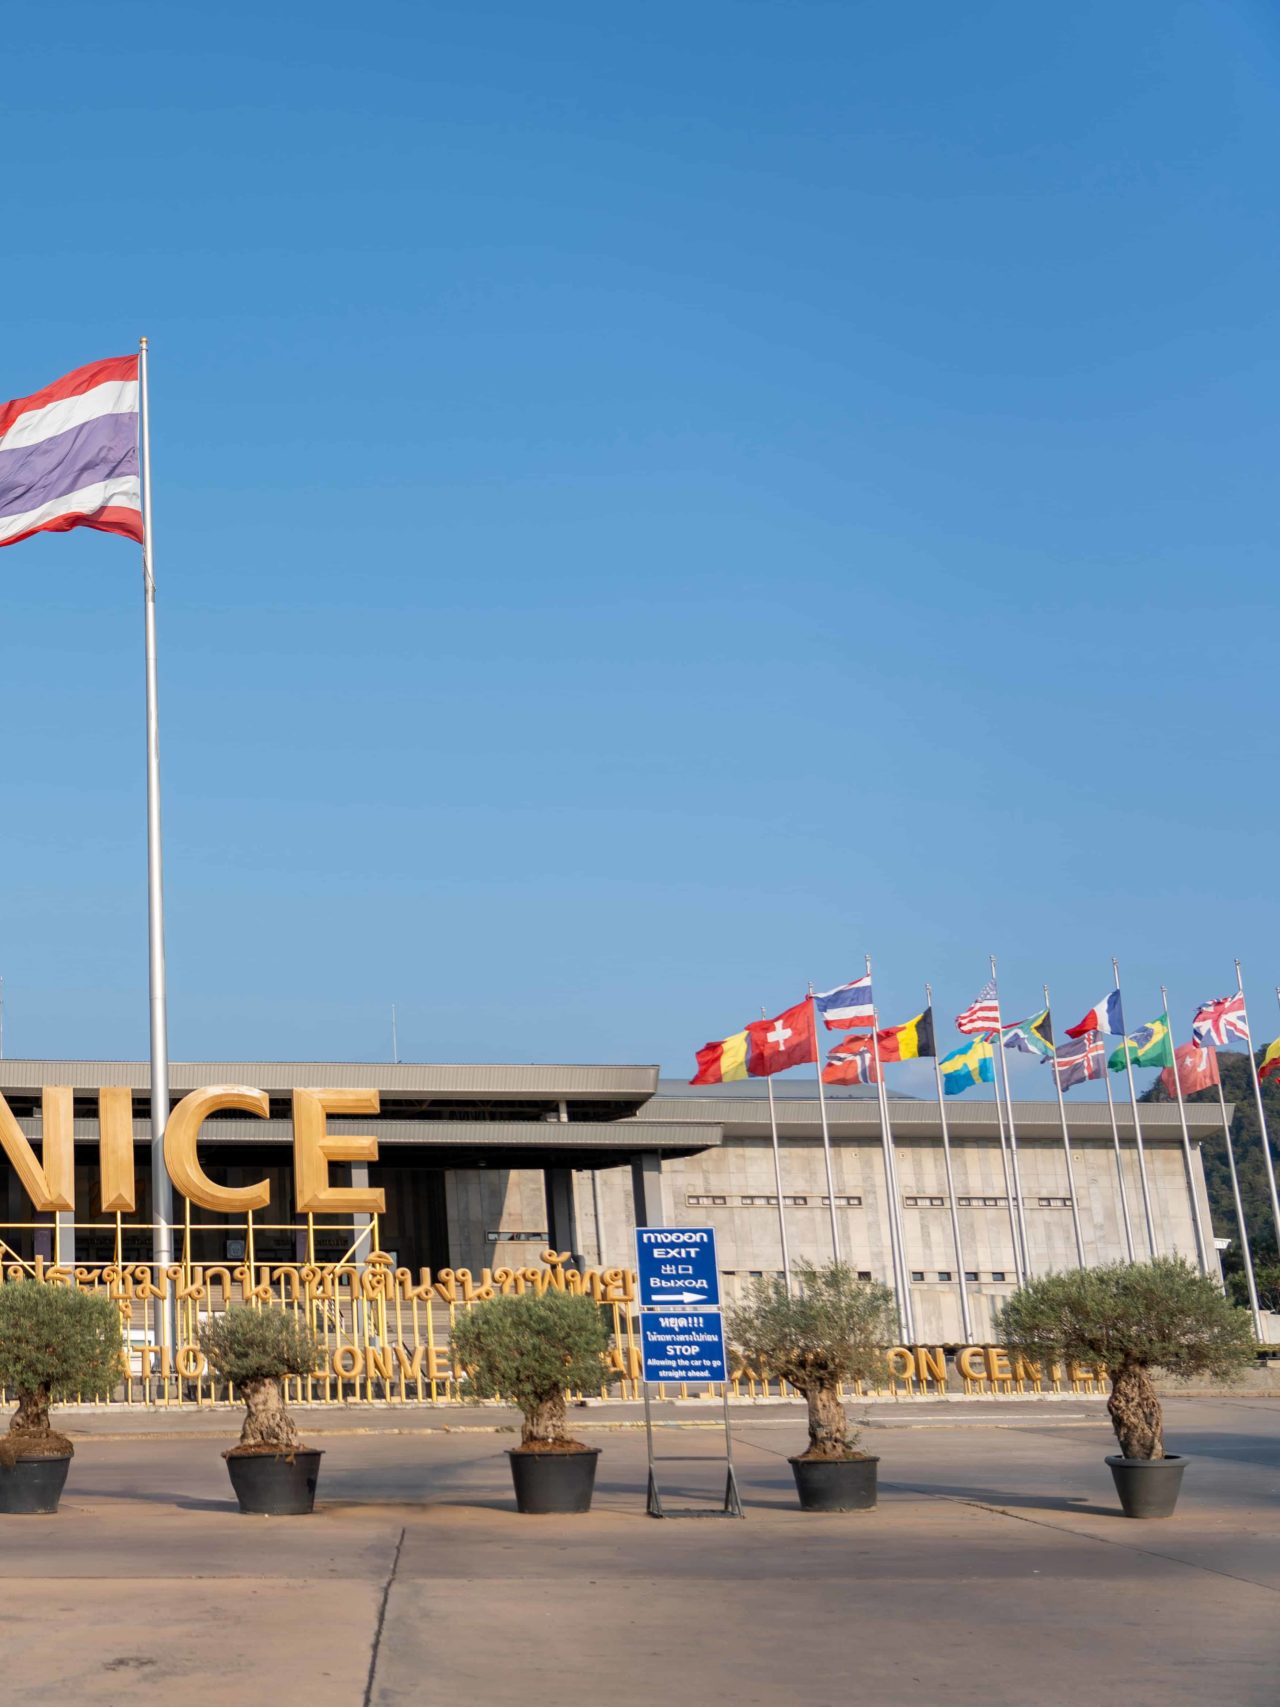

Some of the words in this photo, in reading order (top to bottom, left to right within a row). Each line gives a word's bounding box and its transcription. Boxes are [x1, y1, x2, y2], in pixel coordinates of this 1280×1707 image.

[642, 1232, 708, 1243] ทางออก
[653, 1248, 700, 1258] EXIT
[661, 1264, 693, 1274] 出口
[649, 1277, 708, 1288] Выход
[666, 1345, 700, 1355] STOP
[647, 1358, 677, 1367] Allowing
[677, 1358, 690, 1366] the
[712, 1360, 722, 1368] go
[658, 1370, 687, 1378] straight
